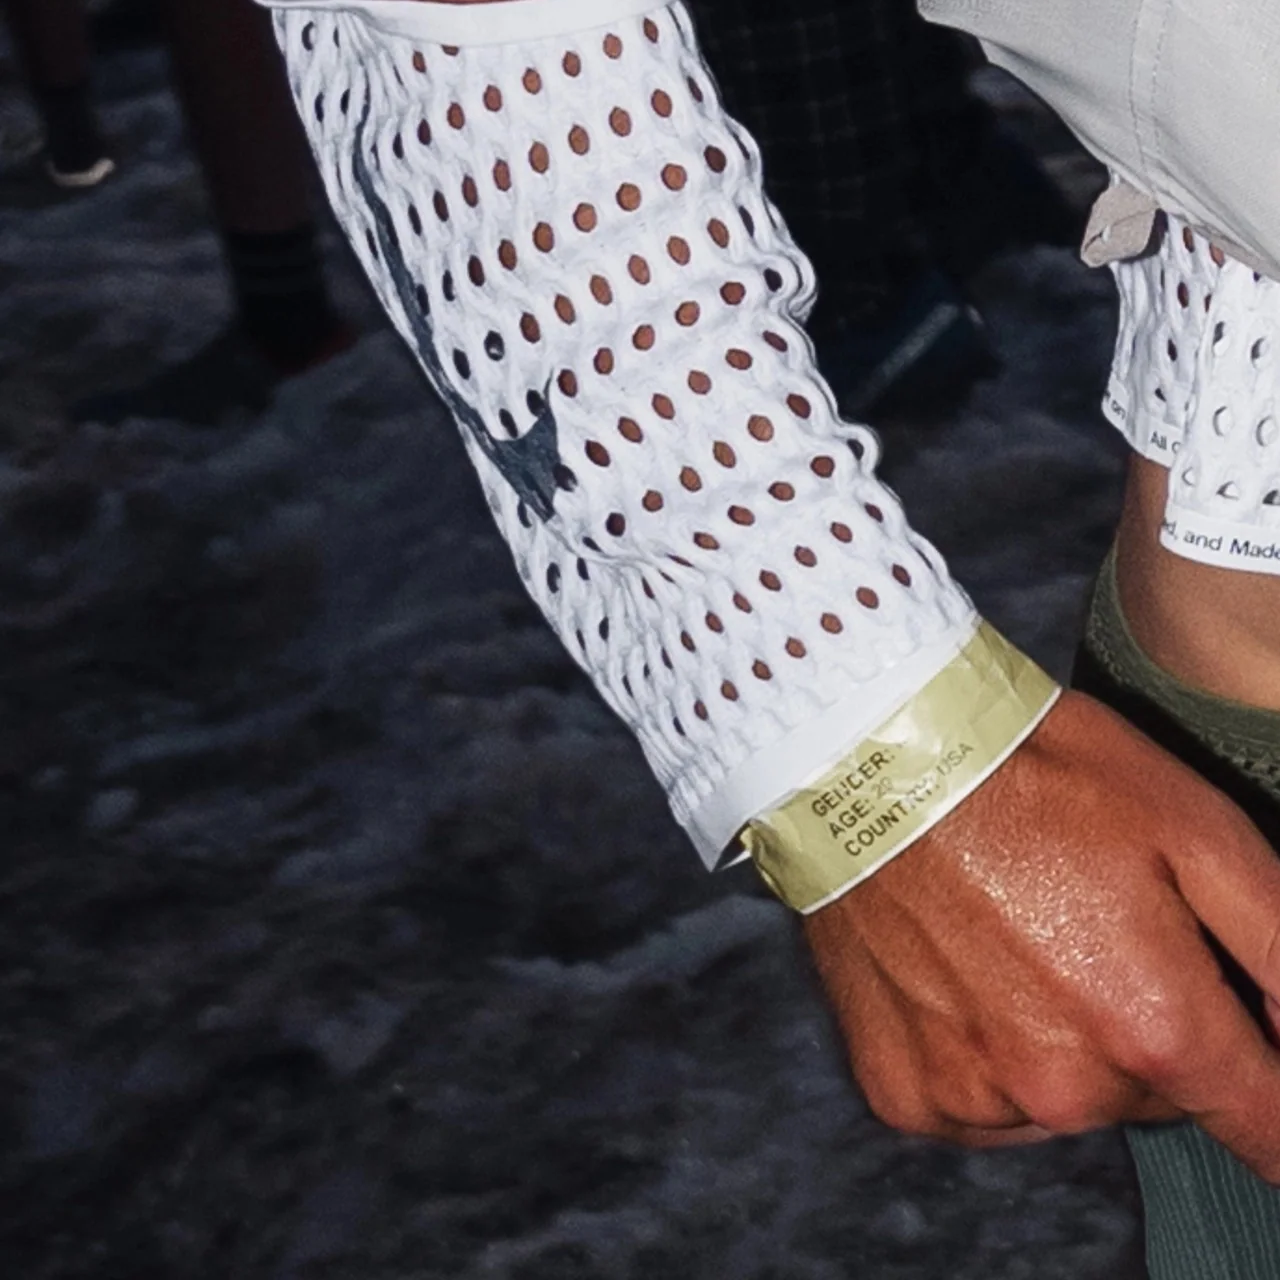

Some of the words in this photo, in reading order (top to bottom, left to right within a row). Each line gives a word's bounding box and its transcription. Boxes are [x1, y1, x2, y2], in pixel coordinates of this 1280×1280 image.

[1183, 530, 1223, 551] and
[936, 742, 974, 776] USA
[828, 798, 875, 840] AGE:
